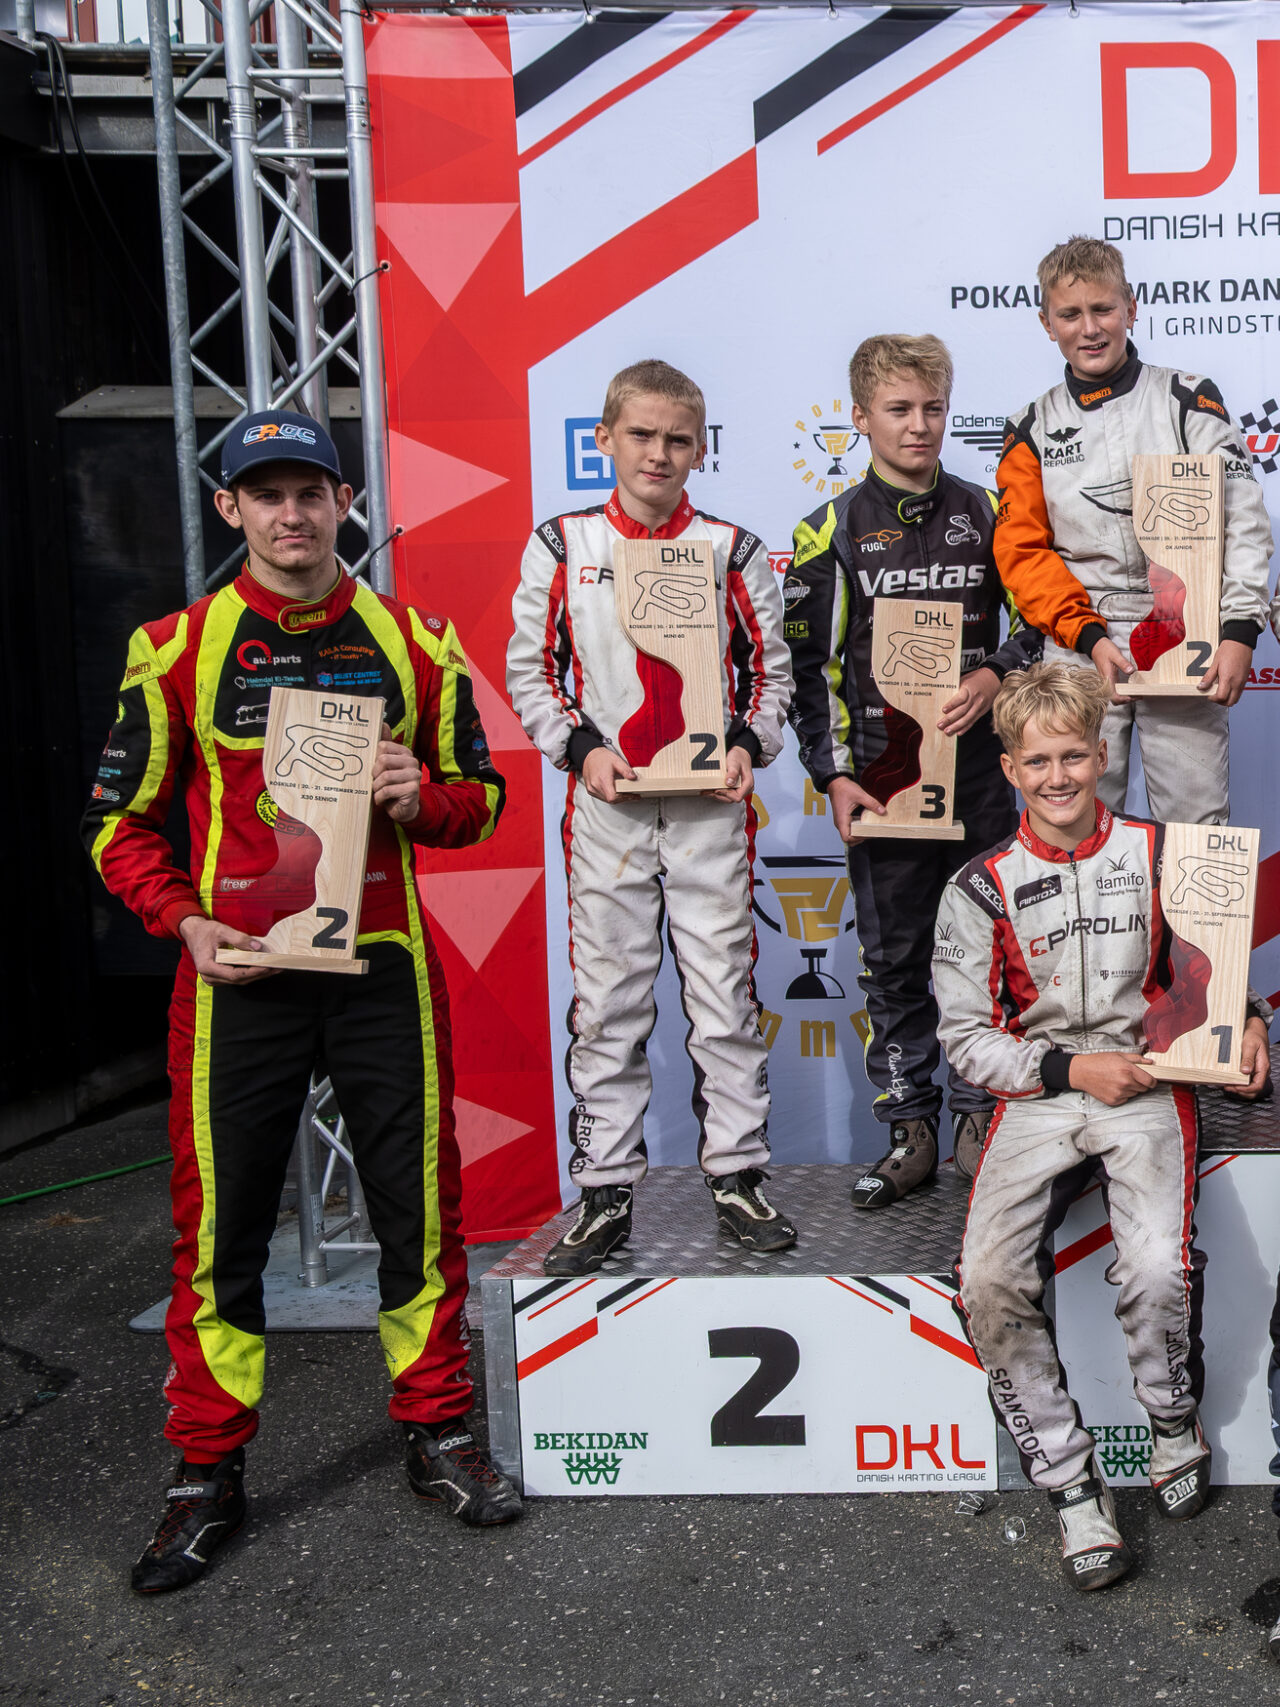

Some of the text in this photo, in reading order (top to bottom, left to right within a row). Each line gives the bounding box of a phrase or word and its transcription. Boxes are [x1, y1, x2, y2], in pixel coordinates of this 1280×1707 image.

[1103, 213, 1223, 241] DANISH
[1132, 279, 1211, 305] MARK
[953, 415, 1009, 428] Odens
[1043, 440, 1084, 460] KART
[1043, 453, 1085, 468] REPUBLIC
[1171, 461, 1211, 478] DKL
[1224, 459, 1252, 473] KAR
[661, 547, 704, 564] DKL
[860, 542, 886, 553] FUGL
[857, 562, 986, 598] Vestas
[783, 621, 808, 634] IRO
[914, 610, 954, 627] DKL
[1185, 640, 1213, 677] 2
[320, 701, 369, 723] DKL
[689, 732, 720, 771] 2
[269, 780, 297, 788] ROSKILDE
[314, 795, 338, 803] SENIOR
[919, 784, 946, 819] 3
[1207, 833, 1249, 853] DKL
[1096, 872, 1145, 890] damifo
[312, 906, 349, 950] 2
[1210, 1025, 1233, 1064] 1
[707, 1326, 807, 1447] 2
[533, 1432, 649, 1451] BEKIDAN
[1087, 1425, 1150, 1443] EKID
[855, 1424, 986, 1470] DKL
[856, 1472, 986, 1483] DANISH KARTING LEAGUE
[1163, 1475, 1198, 1505] OMP
[1073, 1553, 1112, 1573] OMP
